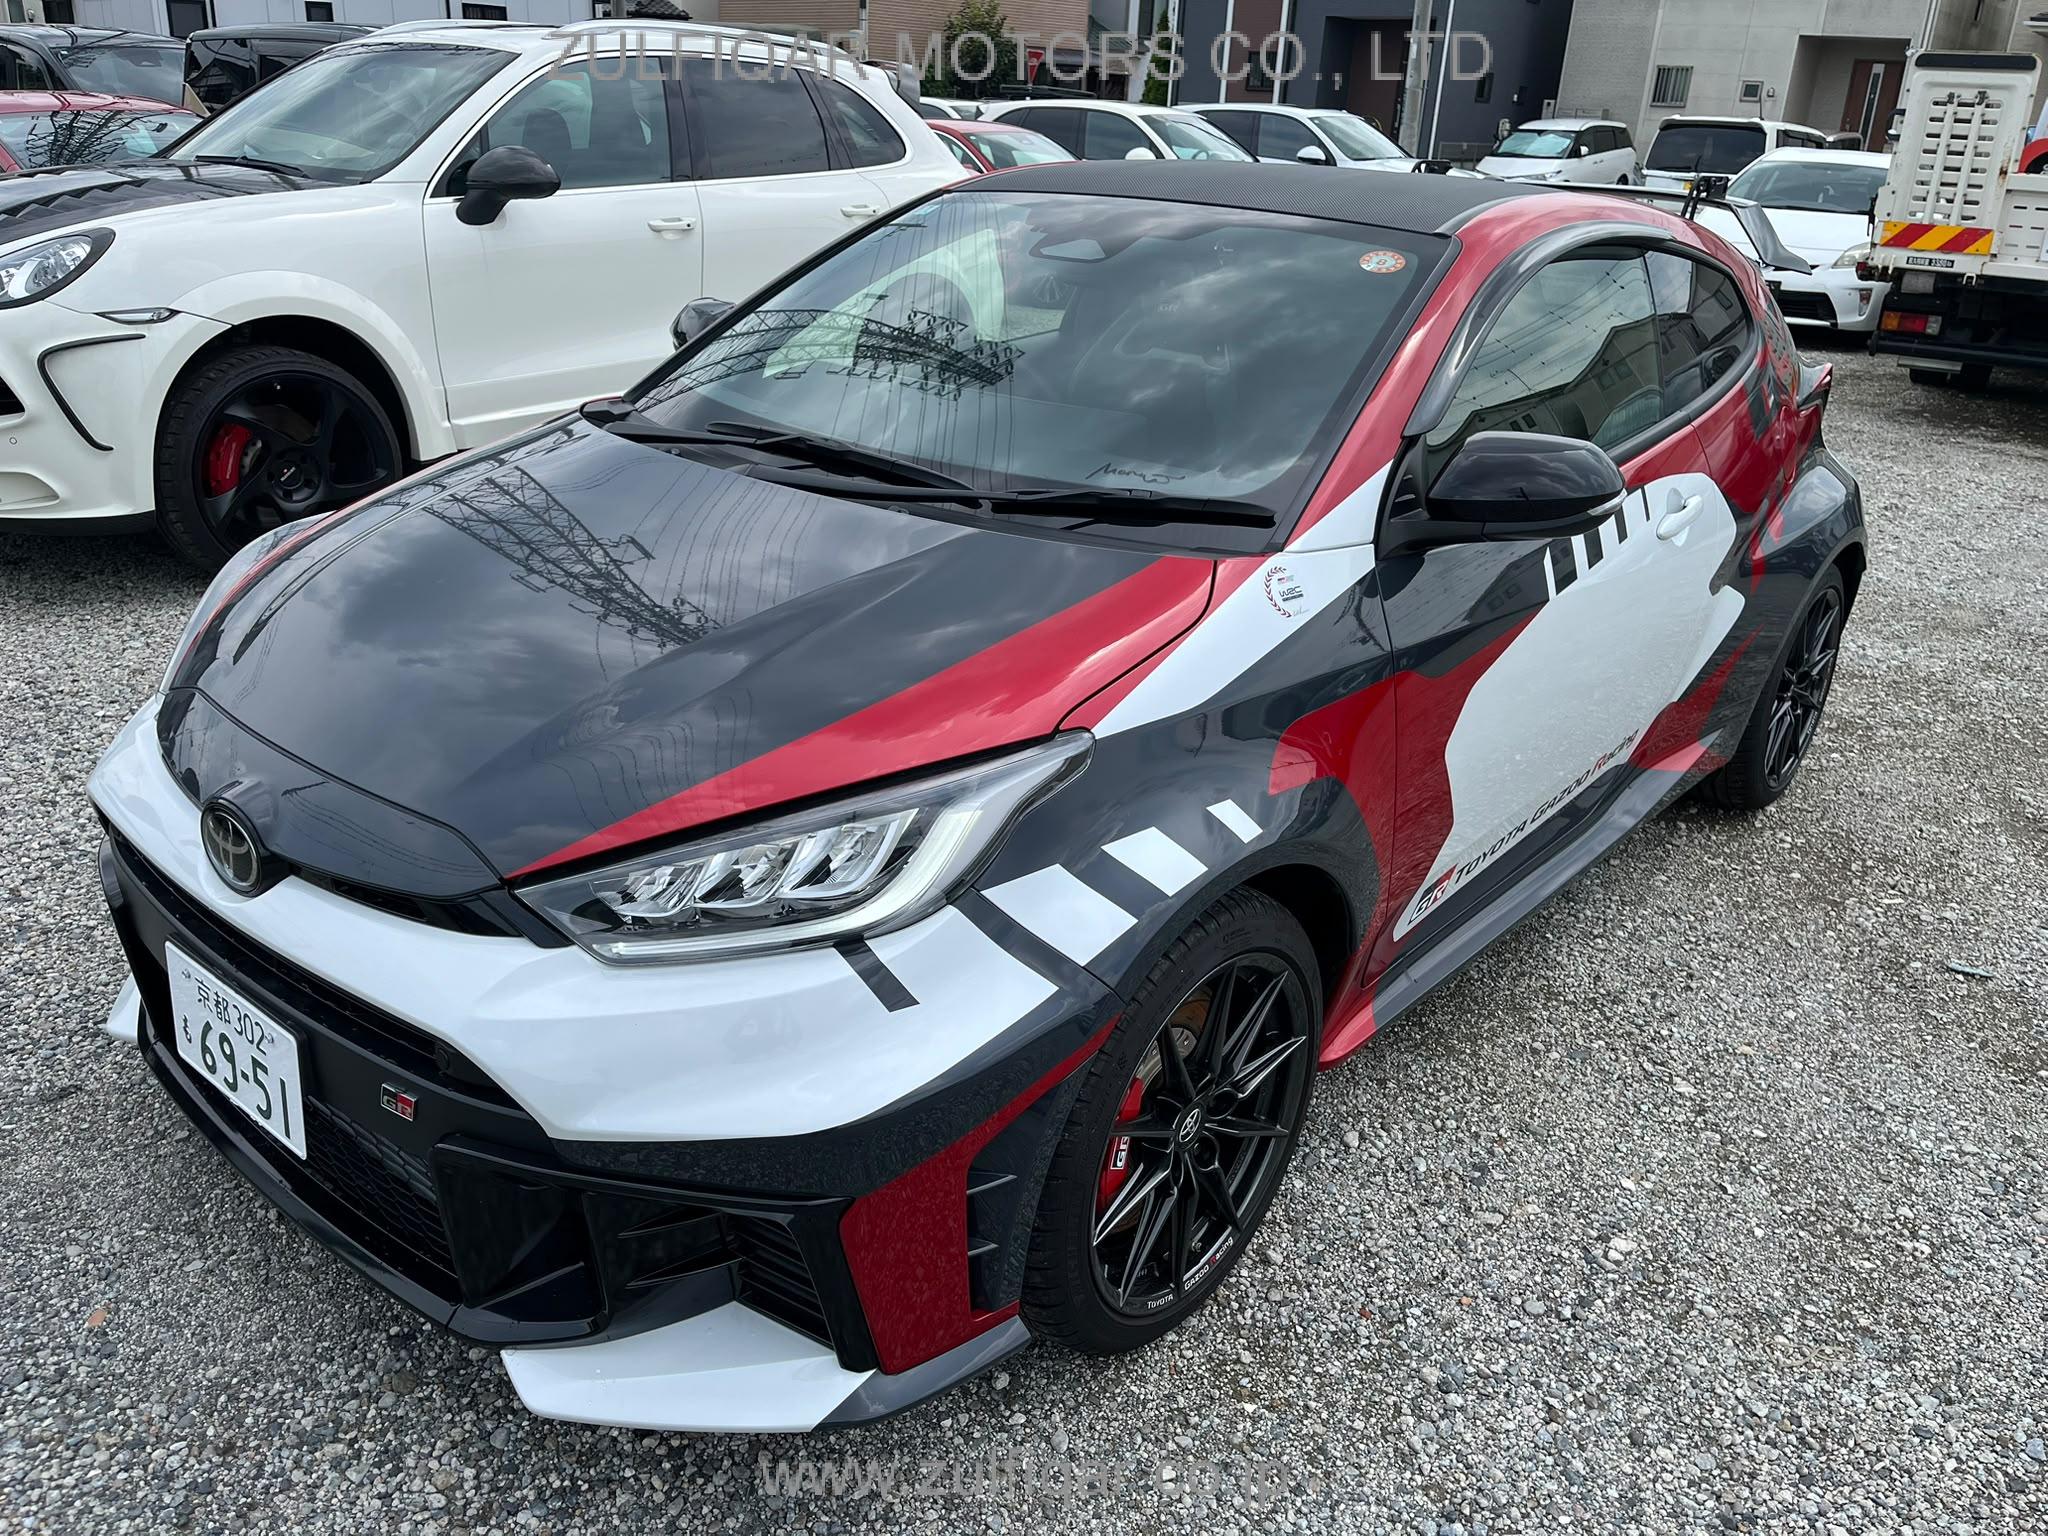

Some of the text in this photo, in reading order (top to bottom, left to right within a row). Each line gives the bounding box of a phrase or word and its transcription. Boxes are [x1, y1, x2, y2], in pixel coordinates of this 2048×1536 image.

[1411, 728, 1639, 918] GR TOYOTA GAZOO Racing
[200, 1020, 291, 1140] 69-51
[382, 1092, 413, 1119] GR
[1147, 1236, 1234, 1310] TOYOTA GAZOO Racing
